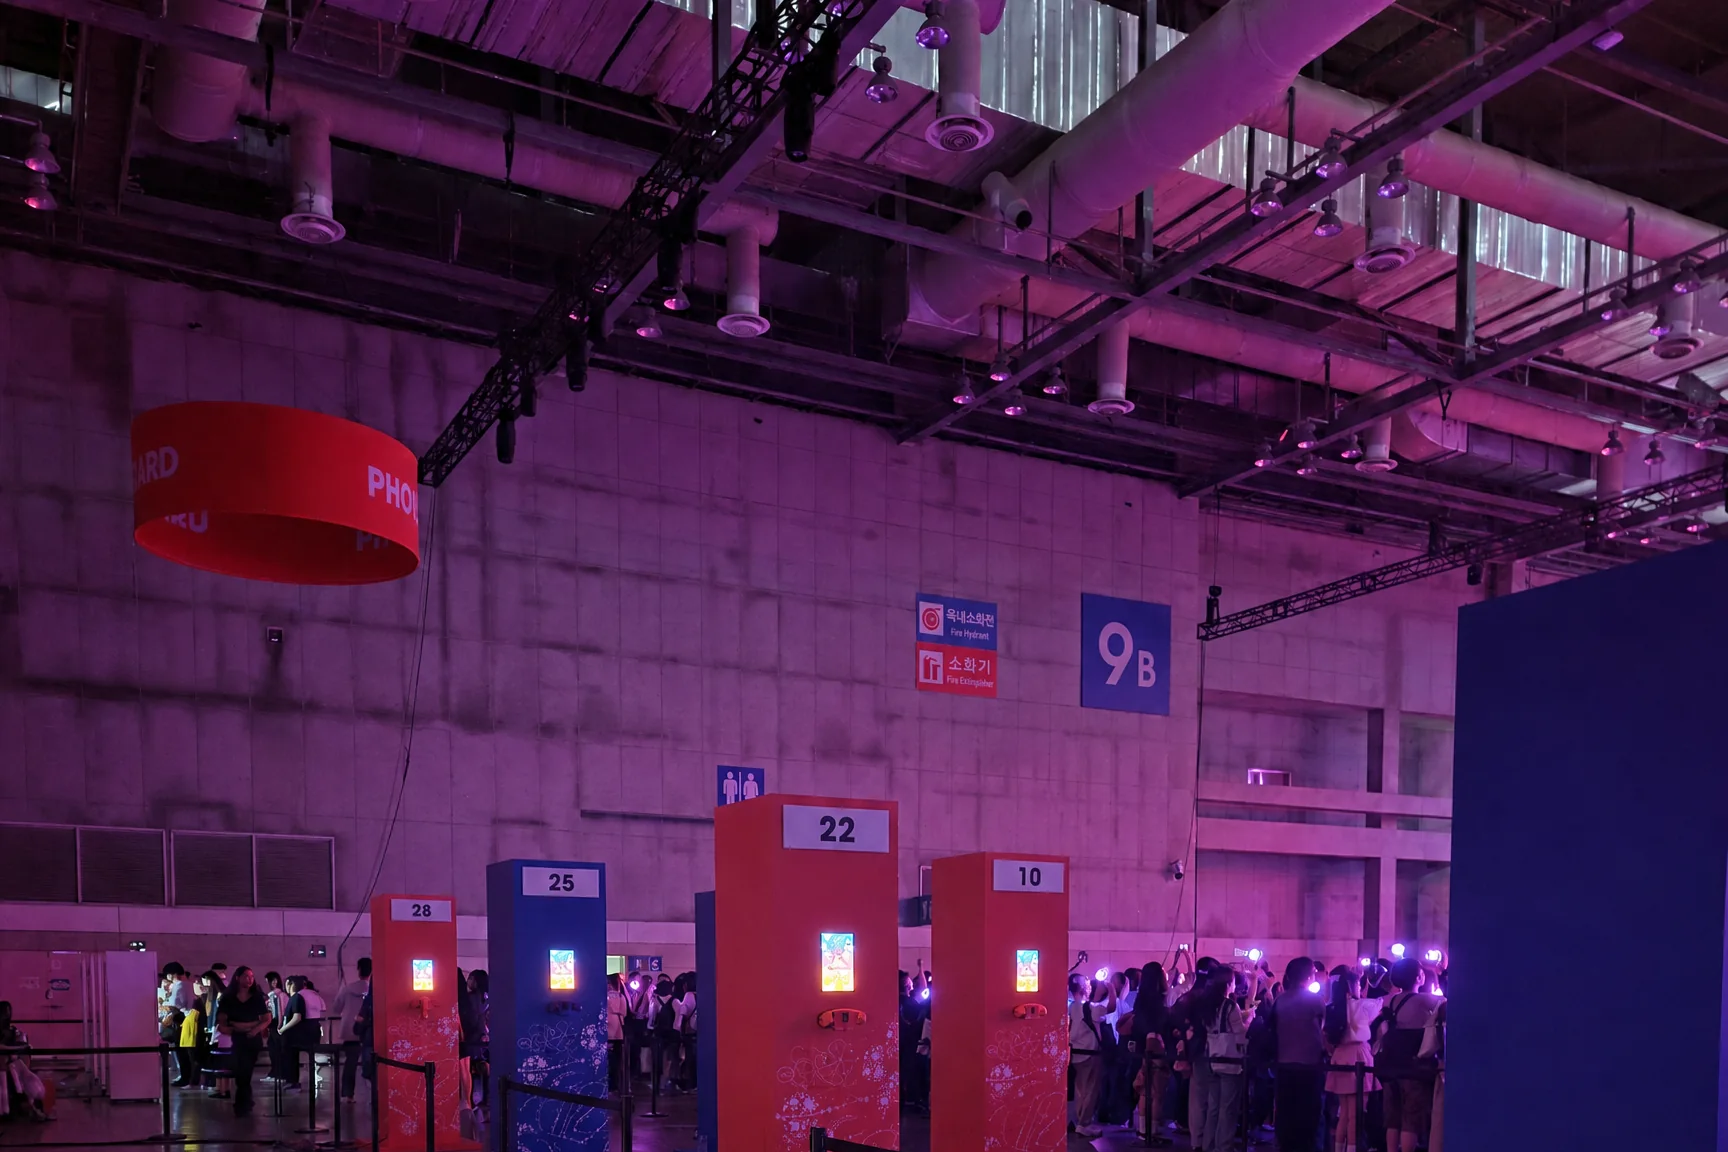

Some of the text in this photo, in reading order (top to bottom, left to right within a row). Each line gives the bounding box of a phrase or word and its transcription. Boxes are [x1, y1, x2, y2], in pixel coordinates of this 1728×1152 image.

[134, 446, 179, 491] ARD
[946, 608, 994, 628] 옥내소화전
[950, 627, 989, 641] Fire Hydrant
[948, 655, 991, 675] 소화기
[947, 675, 959, 685] Fire
[819, 815, 856, 843] 22
[548, 873, 575, 892] 25
[1019, 866, 1042, 887] 10
[411, 903, 432, 918] 28
